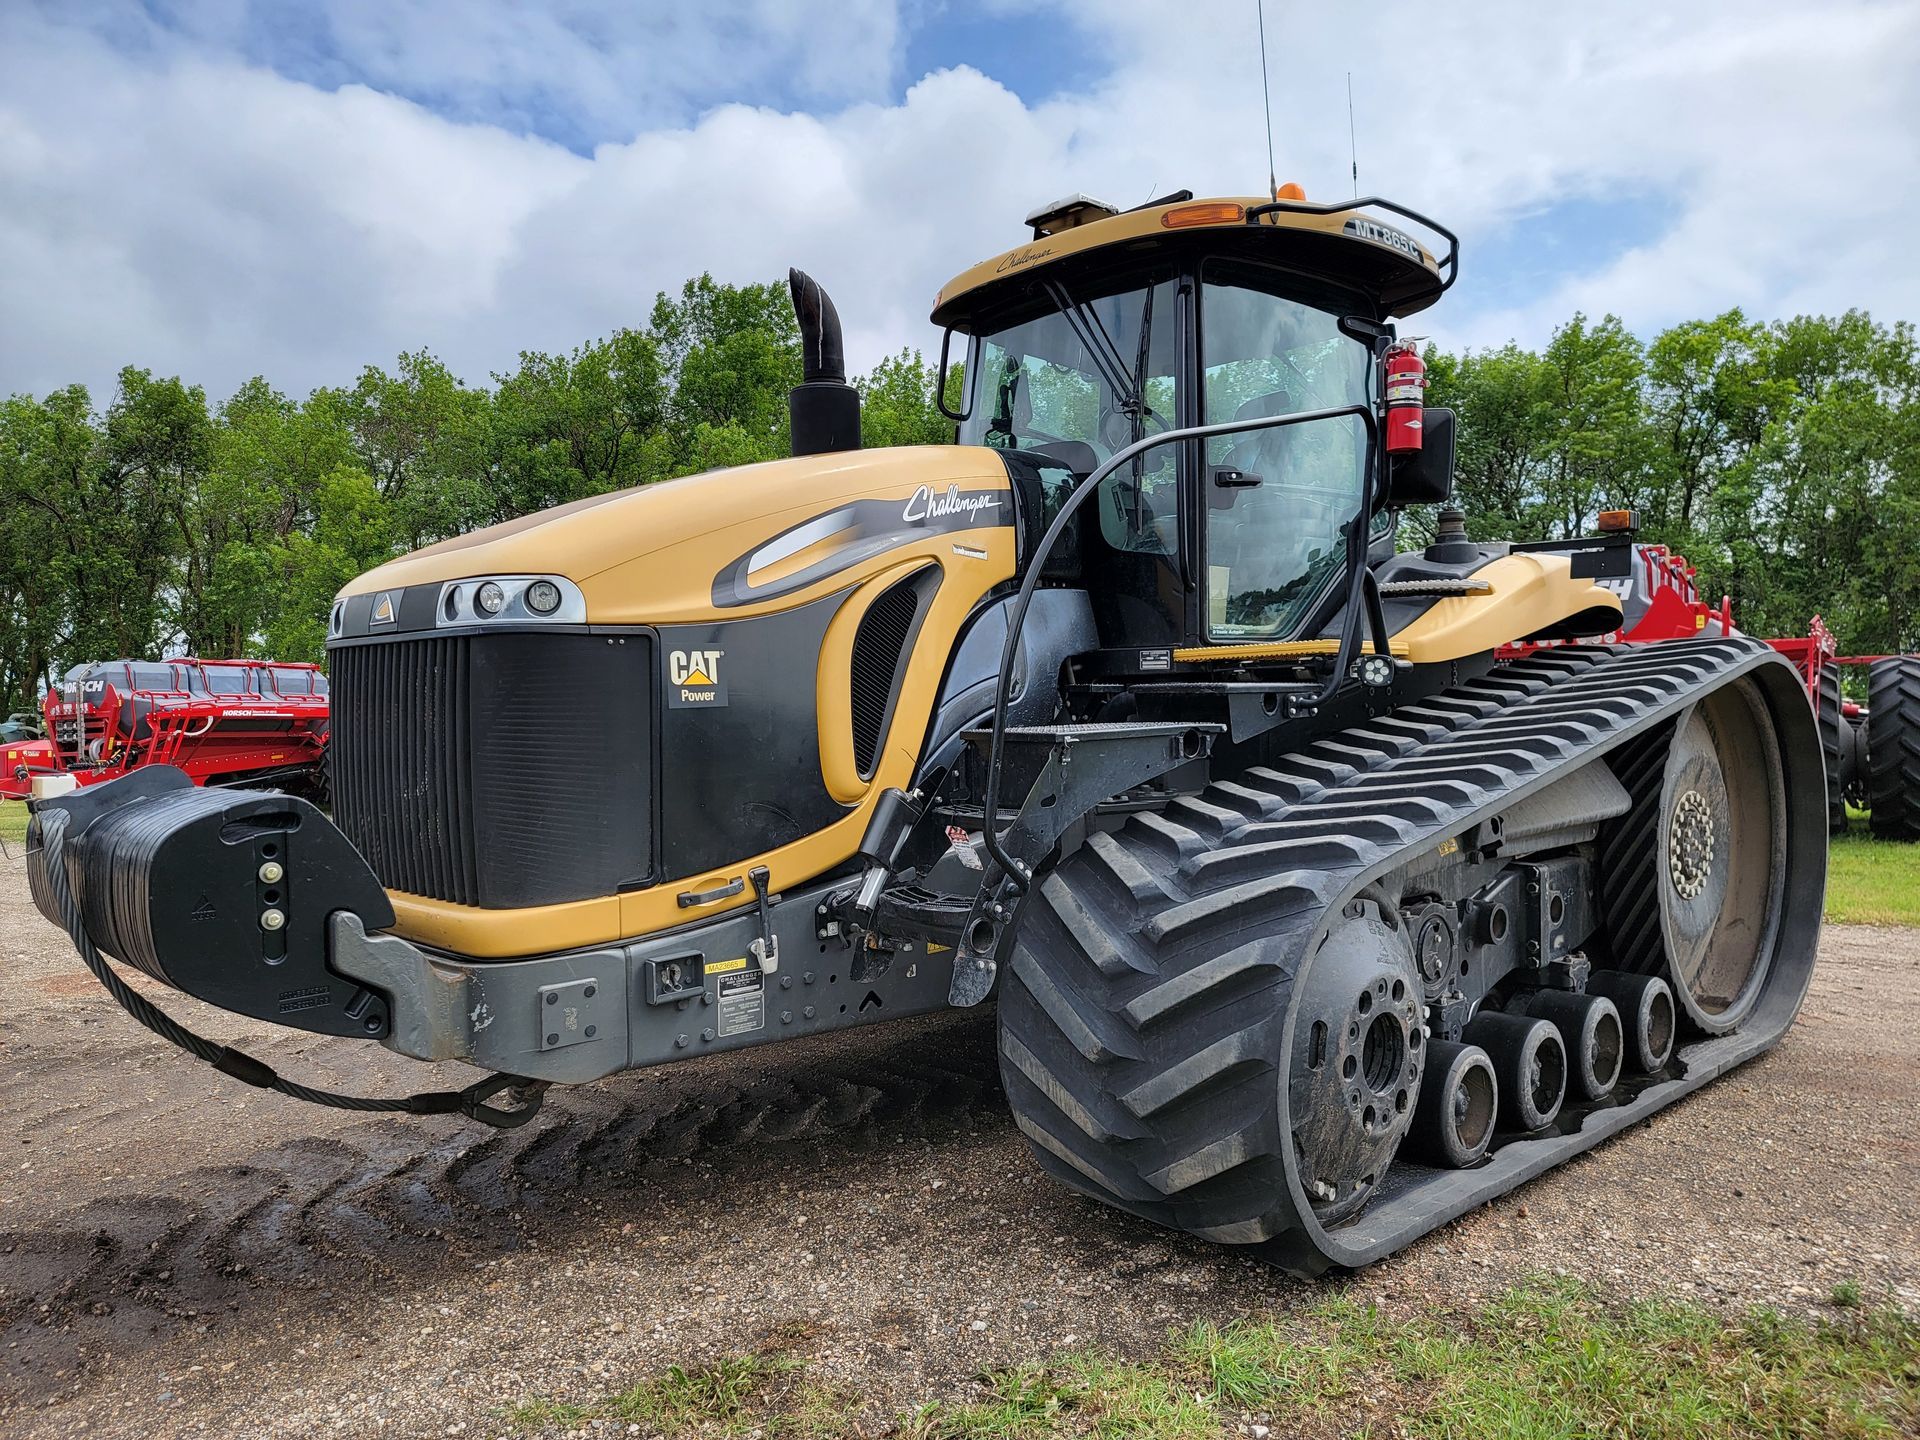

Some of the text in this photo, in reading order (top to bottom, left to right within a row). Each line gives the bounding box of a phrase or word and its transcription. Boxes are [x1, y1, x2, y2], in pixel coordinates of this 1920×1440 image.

[1355, 219, 1419, 257] MT865C
[996, 248, 1061, 273] Challenger
[903, 484, 1003, 523] Challenger
[669, 650, 720, 686] CAT
[681, 689, 716, 702] Power
[222, 709, 252, 717] HORSCH
[720, 971, 762, 983] CHALLENGER
